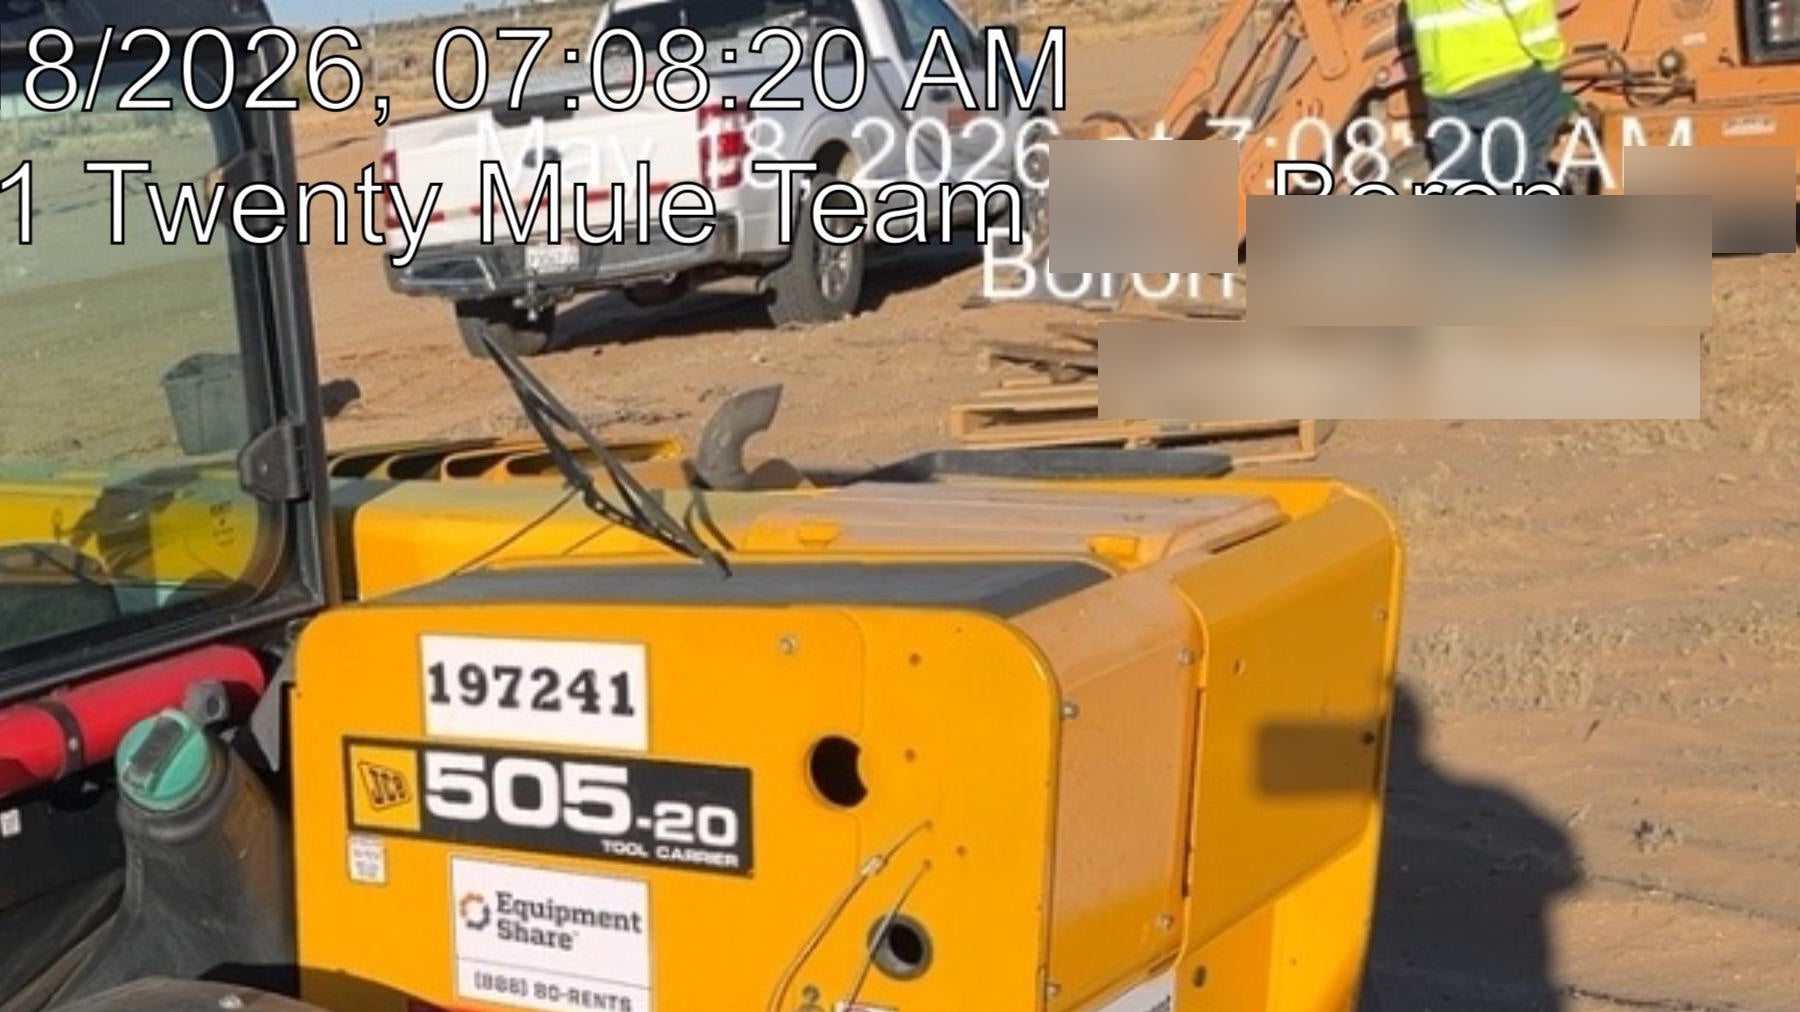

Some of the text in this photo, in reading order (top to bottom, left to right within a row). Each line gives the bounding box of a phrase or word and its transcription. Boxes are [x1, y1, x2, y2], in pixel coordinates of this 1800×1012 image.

[428, 660, 636, 717] 197241
[424, 750, 739, 848] 505-20
[602, 838, 739, 868] TOOL CARRIER
[496, 890, 643, 935] Equipment
[497, 917, 575, 951] Share
